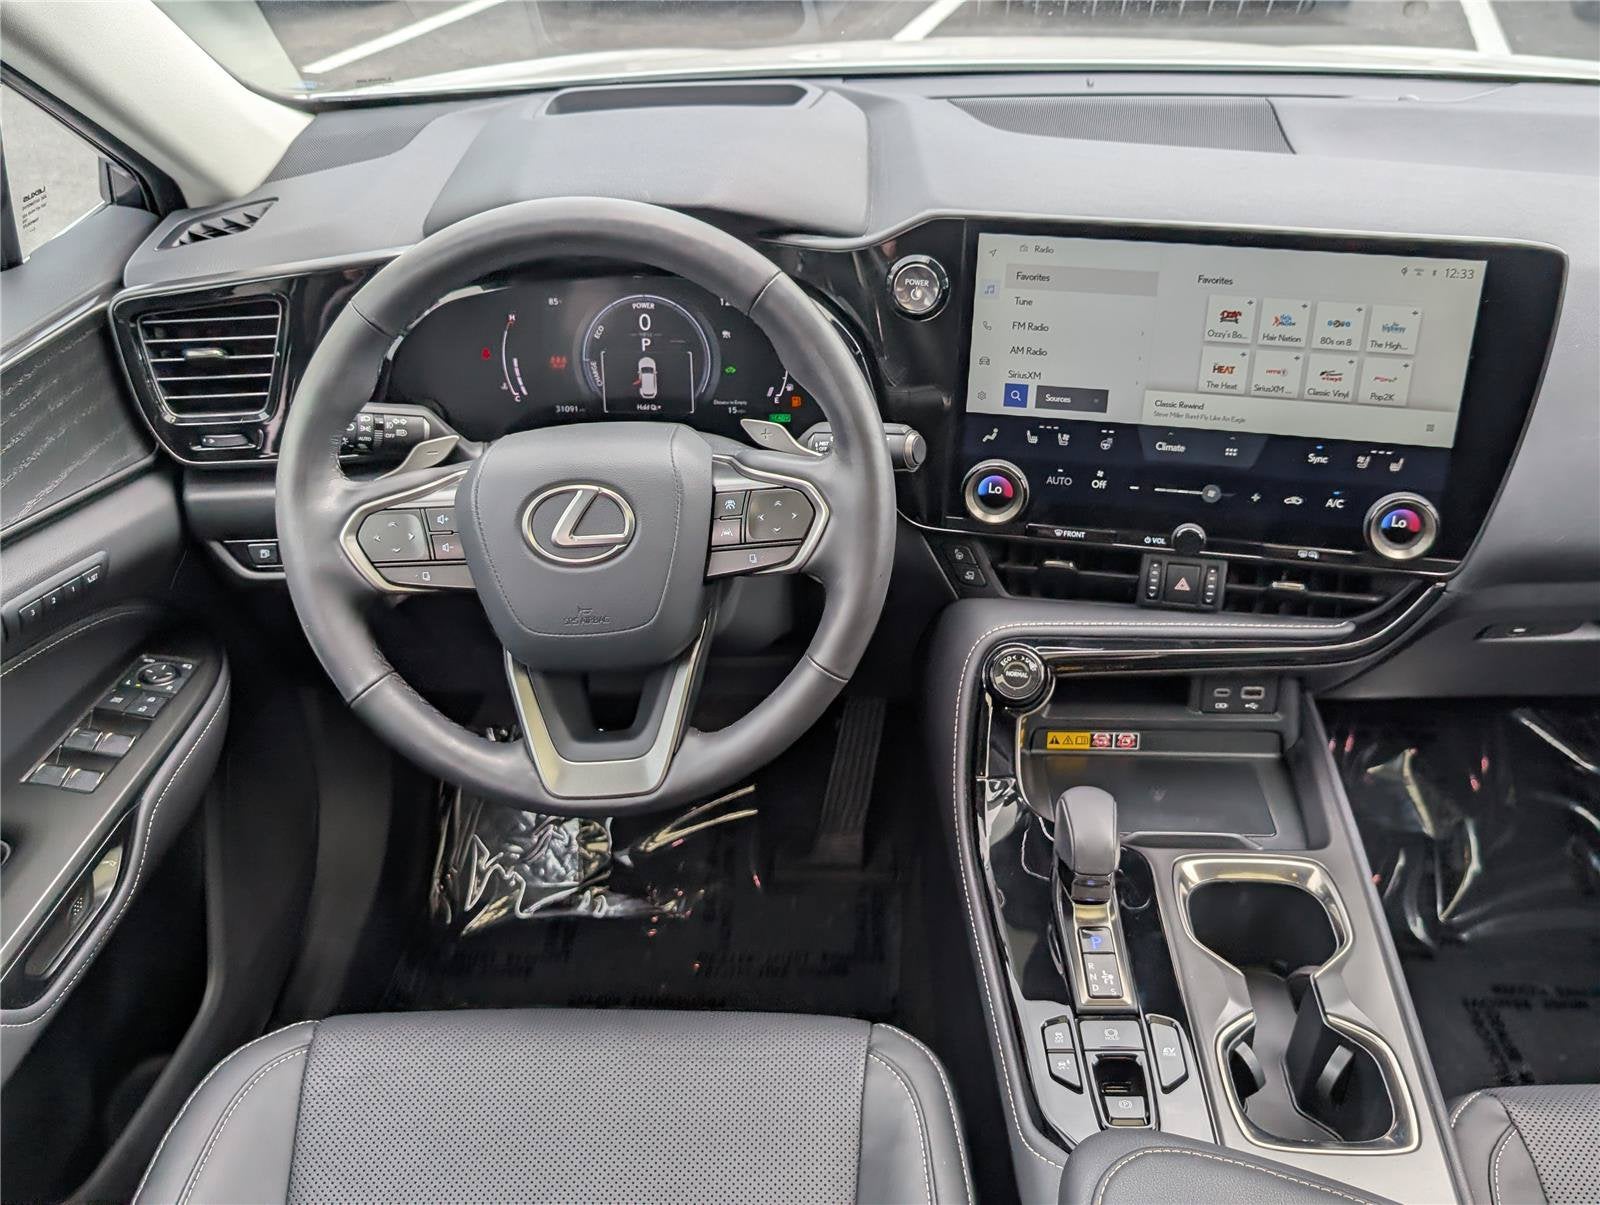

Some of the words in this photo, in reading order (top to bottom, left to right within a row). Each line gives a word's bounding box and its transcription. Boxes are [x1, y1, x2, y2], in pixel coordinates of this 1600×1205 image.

[1034, 244, 1055, 254] Radio
[1016, 271, 1051, 282] Favorites
[1444, 267, 1475, 280] 12:33
[904, 278, 930, 287] POWER
[1197, 274, 1234, 286] Favorites
[632, 302, 656, 310] POWER
[1014, 296, 1033, 306] Tune
[1012, 321, 1026, 330] FM
[1028, 322, 1050, 332] Radio
[1207, 328, 1231, 340] Ozzy's
[1262, 333, 1277, 342] Hair
[1278, 335, 1302, 343] Nation
[641, 338, 652, 352] P
[1319, 336, 1334, 345] 80s
[1335, 338, 1345, 346] on
[1345, 338, 1353, 347] 8
[1370, 339, 1384, 348] The
[1009, 346, 1025, 355] AM
[1026, 347, 1048, 357] Radio
[1007, 369, 1042, 380] SiriusXM
[1212, 365, 1236, 375] HEAT
[1206, 380, 1220, 389] The
[1220, 382, 1238, 390] Heat
[1045, 393, 1072, 403] Sources
[1306, 387, 1331, 398] Classic
[1332, 389, 1350, 399] Vinyl
[555, 405, 579, 413] 31091
[1154, 399, 1177, 408] Classic
[1178, 401, 1205, 411] Rewind
[1155, 441, 1186, 453] Climate
[1307, 453, 1329, 464] Sync
[1046, 475, 1073, 487] AUTO
[1091, 479, 1107, 490] Off
[988, 481, 1002, 496] Lo
[1325, 498, 1345, 509] A/C
[1390, 515, 1408, 529] Lo
[1062, 530, 1086, 540] FRONT
[1152, 537, 1166, 546] VOL
[1000, 655, 1012, 667] ECO
[1005, 670, 1029, 679] NORMAL
[1090, 937, 1102, 949] P
[1087, 962, 1095, 970] R
[1089, 973, 1098, 981] N
[1091, 983, 1100, 992] D
